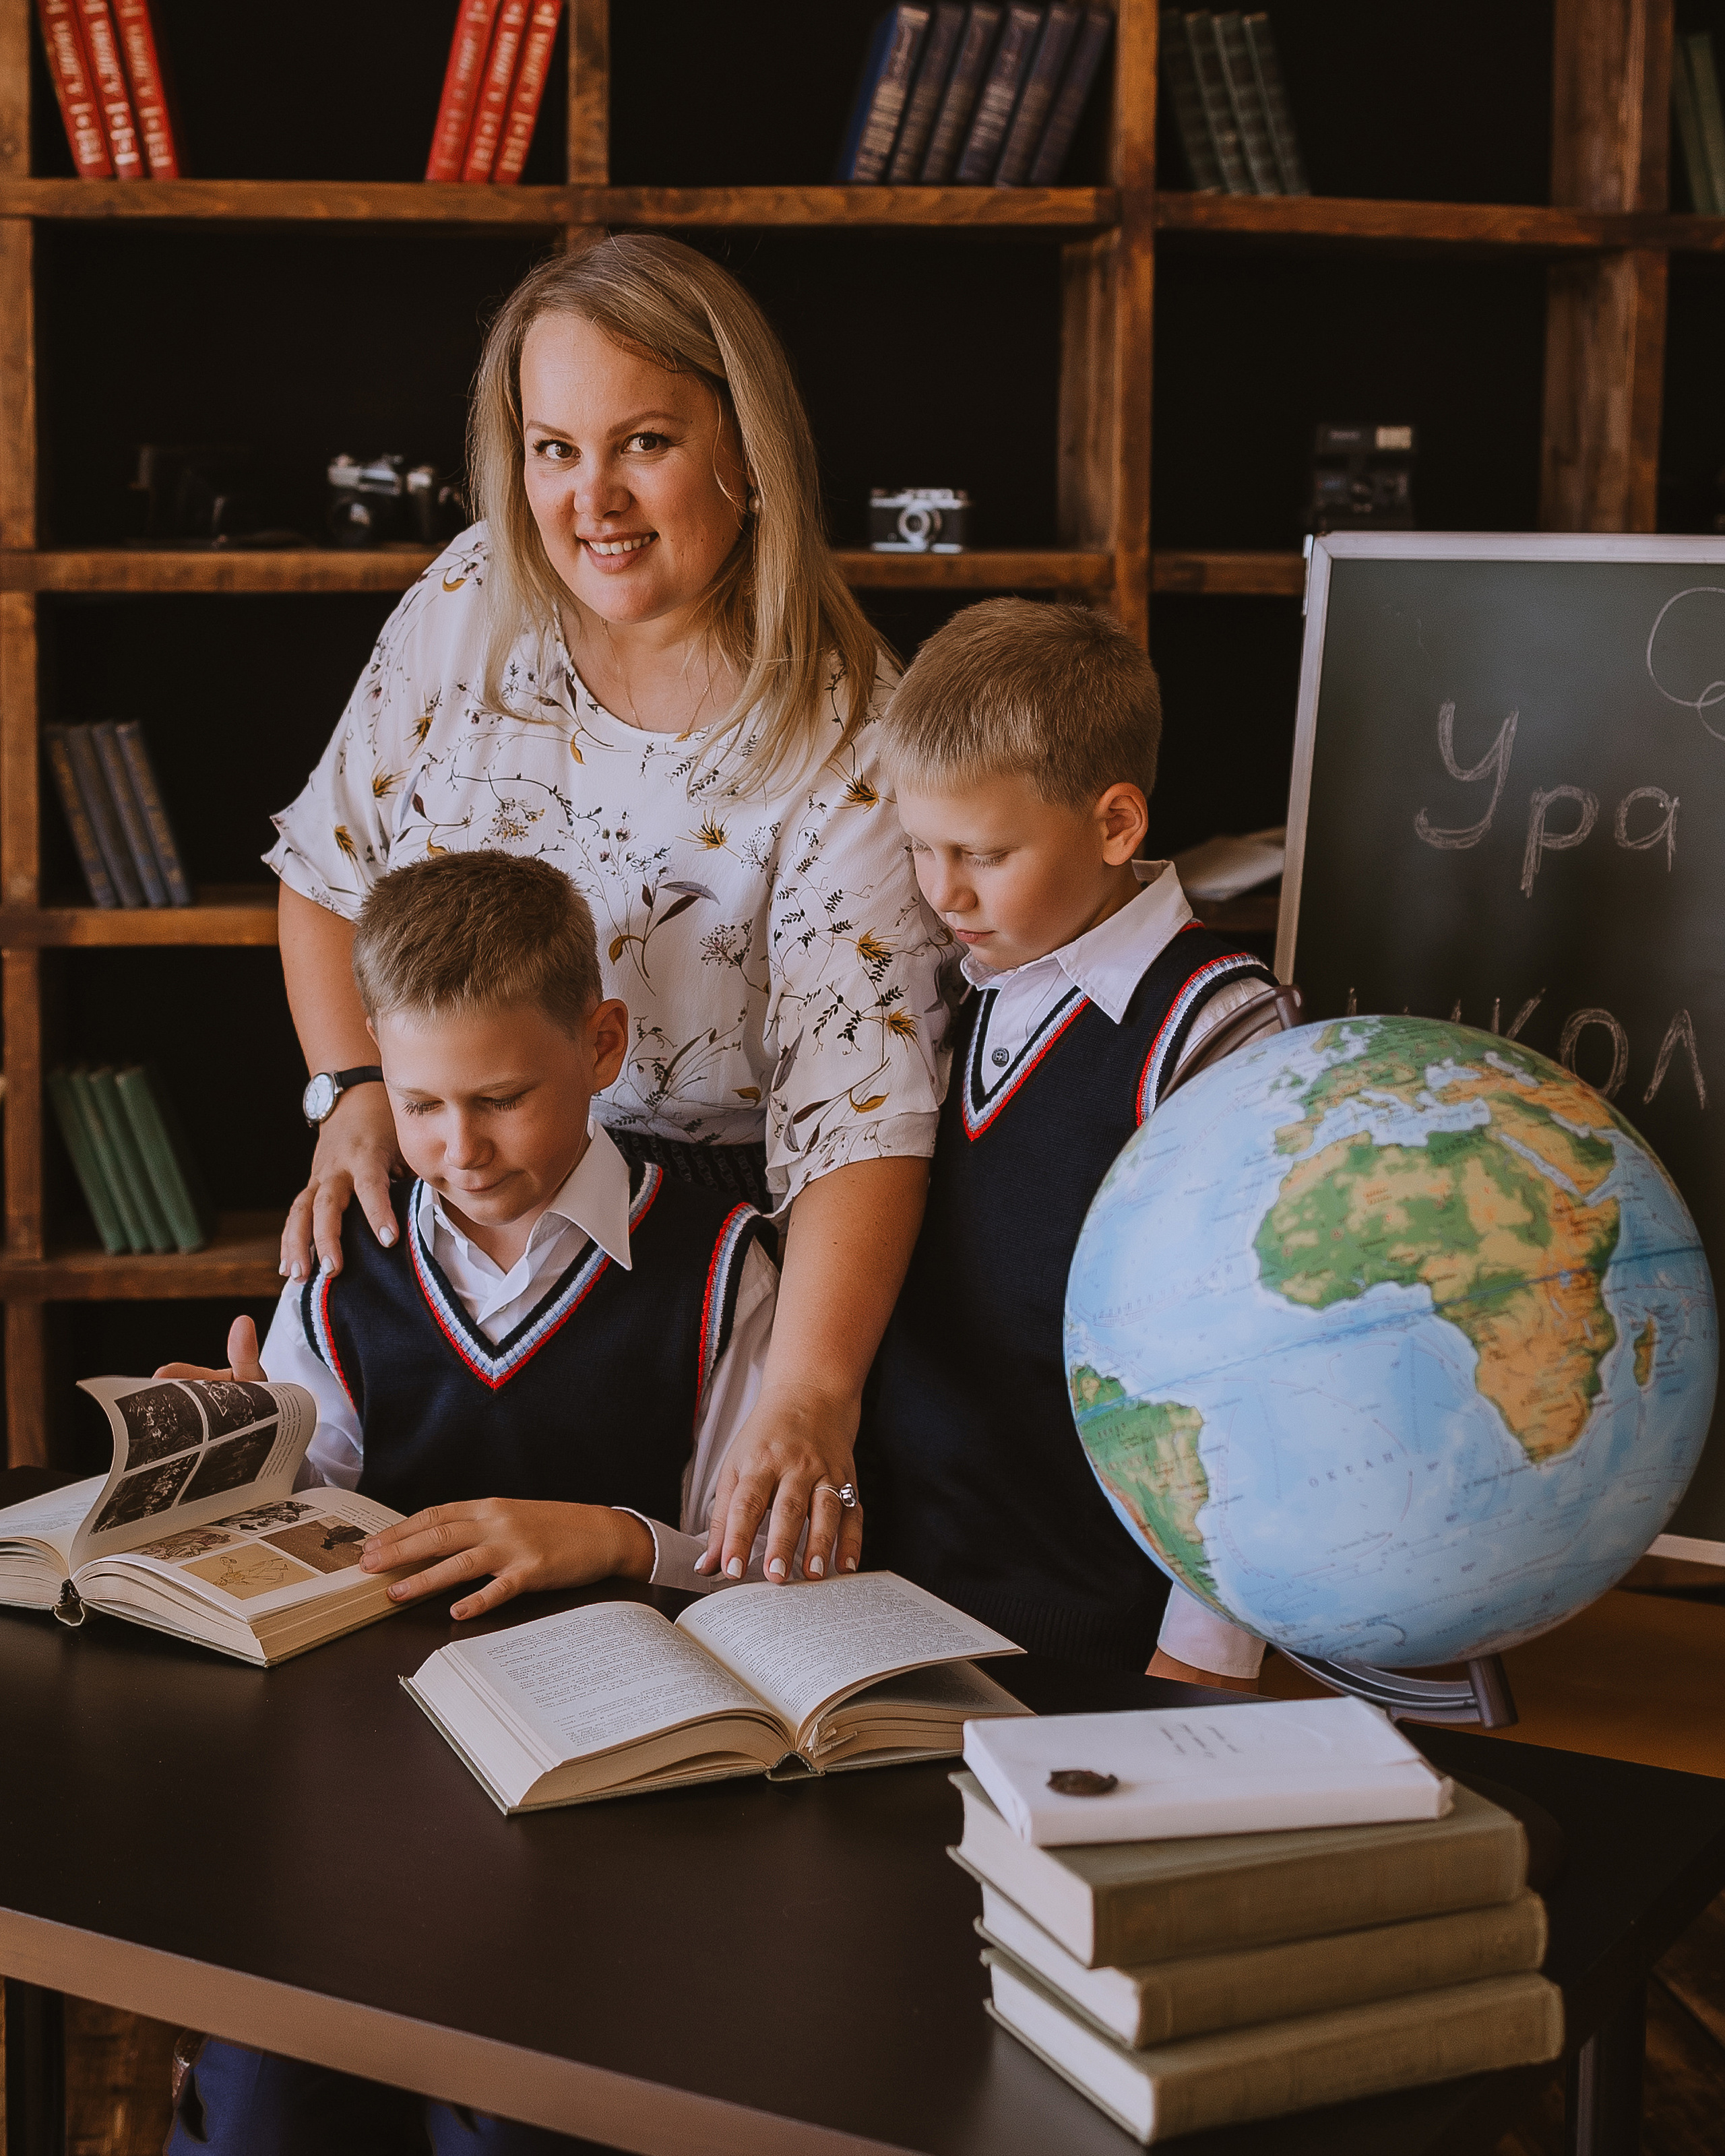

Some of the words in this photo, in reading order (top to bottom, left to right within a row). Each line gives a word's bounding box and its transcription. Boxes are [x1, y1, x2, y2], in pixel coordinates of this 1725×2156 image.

[1413, 699, 1681, 899] Ура
[1346, 988, 1707, 1110] КОЛ
[1307, 1452, 1395, 1488] ОКЕАН
